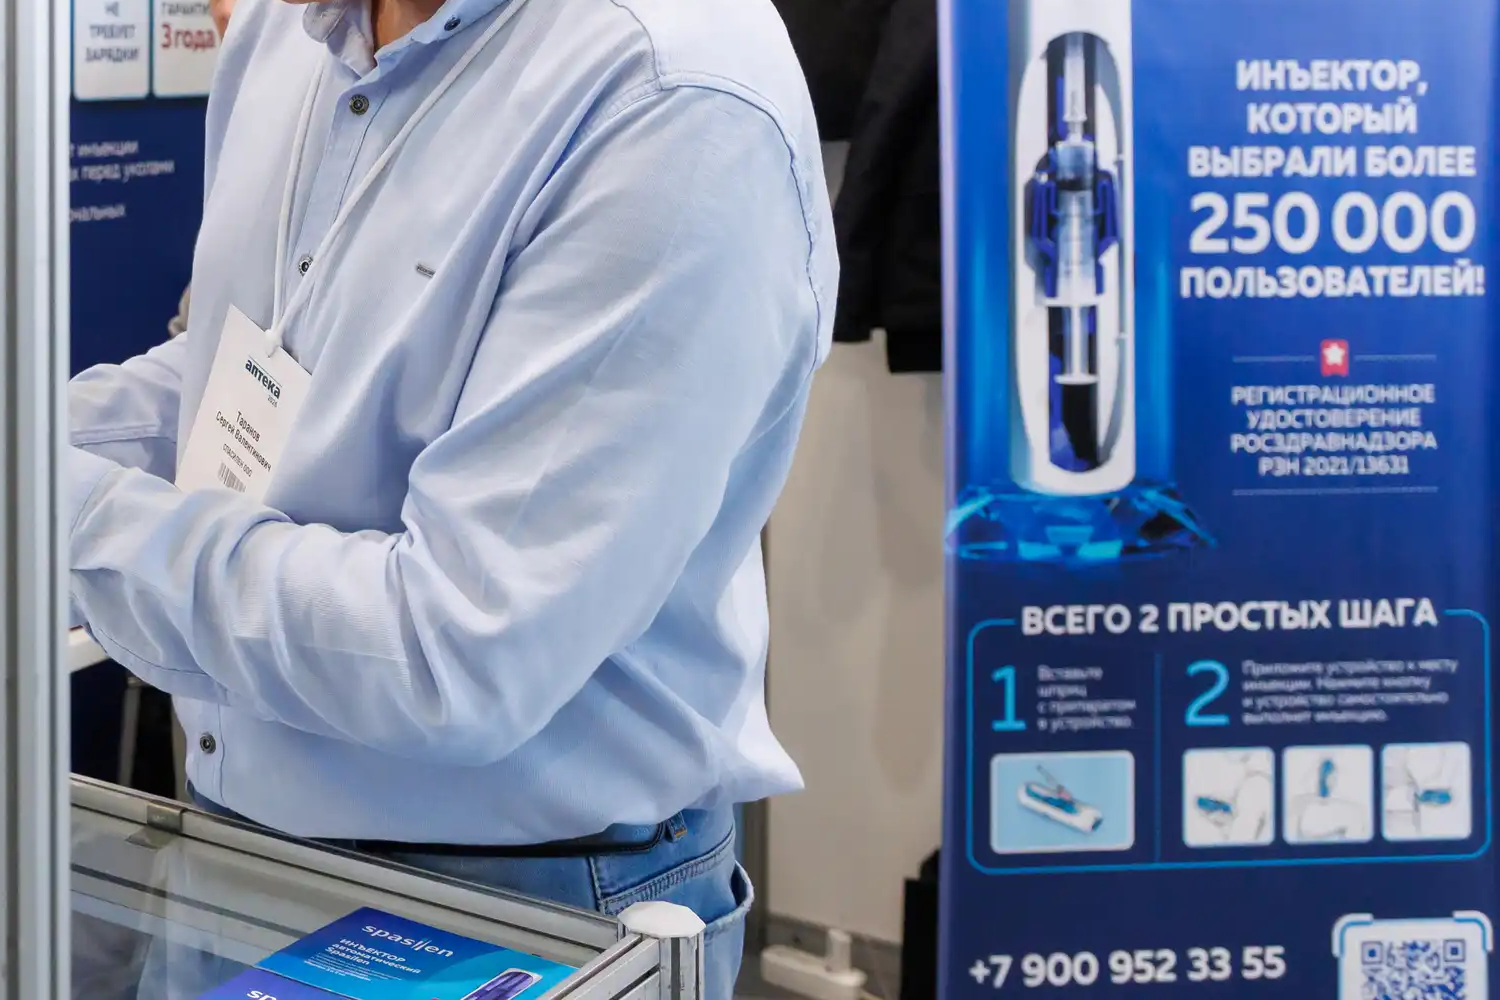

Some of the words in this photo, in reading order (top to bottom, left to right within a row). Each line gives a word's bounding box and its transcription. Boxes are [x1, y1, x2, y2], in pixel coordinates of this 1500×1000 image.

[1235, 59, 1429, 96] ИНЪЕКТОР,
[1246, 96, 1418, 135] КОТОРЫЙ
[1187, 145, 1357, 178] ВЫБРАЛИ
[1364, 145, 1477, 178] БОЛЕЕ
[1189, 190, 1320, 254] 250
[1330, 190, 1476, 254] 000
[1180, 258, 1486, 299] ПОЛЬЗОВАТЕЛЕЙ!
[244, 358, 281, 400] аптека
[1231, 383, 1436, 406] РЕГИСТРАЦИОННОЕ
[215, 410, 235, 436] Сергей
[236, 411, 261, 443] Таранов
[1246, 407, 1421, 431] УДОСТОВЕРЕНИЕ
[1230, 430, 1438, 454] РОСЗДРАВНАДЗОРА
[1258, 456, 1299, 477] РЗН
[1022, 605, 1131, 635] ВСЕГО
[1139, 607, 1159, 632] 2
[1168, 599, 1331, 632] ПРОСТЫХ
[1339, 597, 1438, 629] ШАГА
[991, 665, 1026, 732] 1
[1185, 659, 1230, 727] 2
[339, 938, 406, 963] ИНЪЕКТОР
[968, 954, 1013, 989] +7
[1020, 951, 1099, 987] 900
[1108, 948, 1177, 984] 952
[1186, 947, 1232, 981] 33
[1241, 945, 1286, 980] 55
